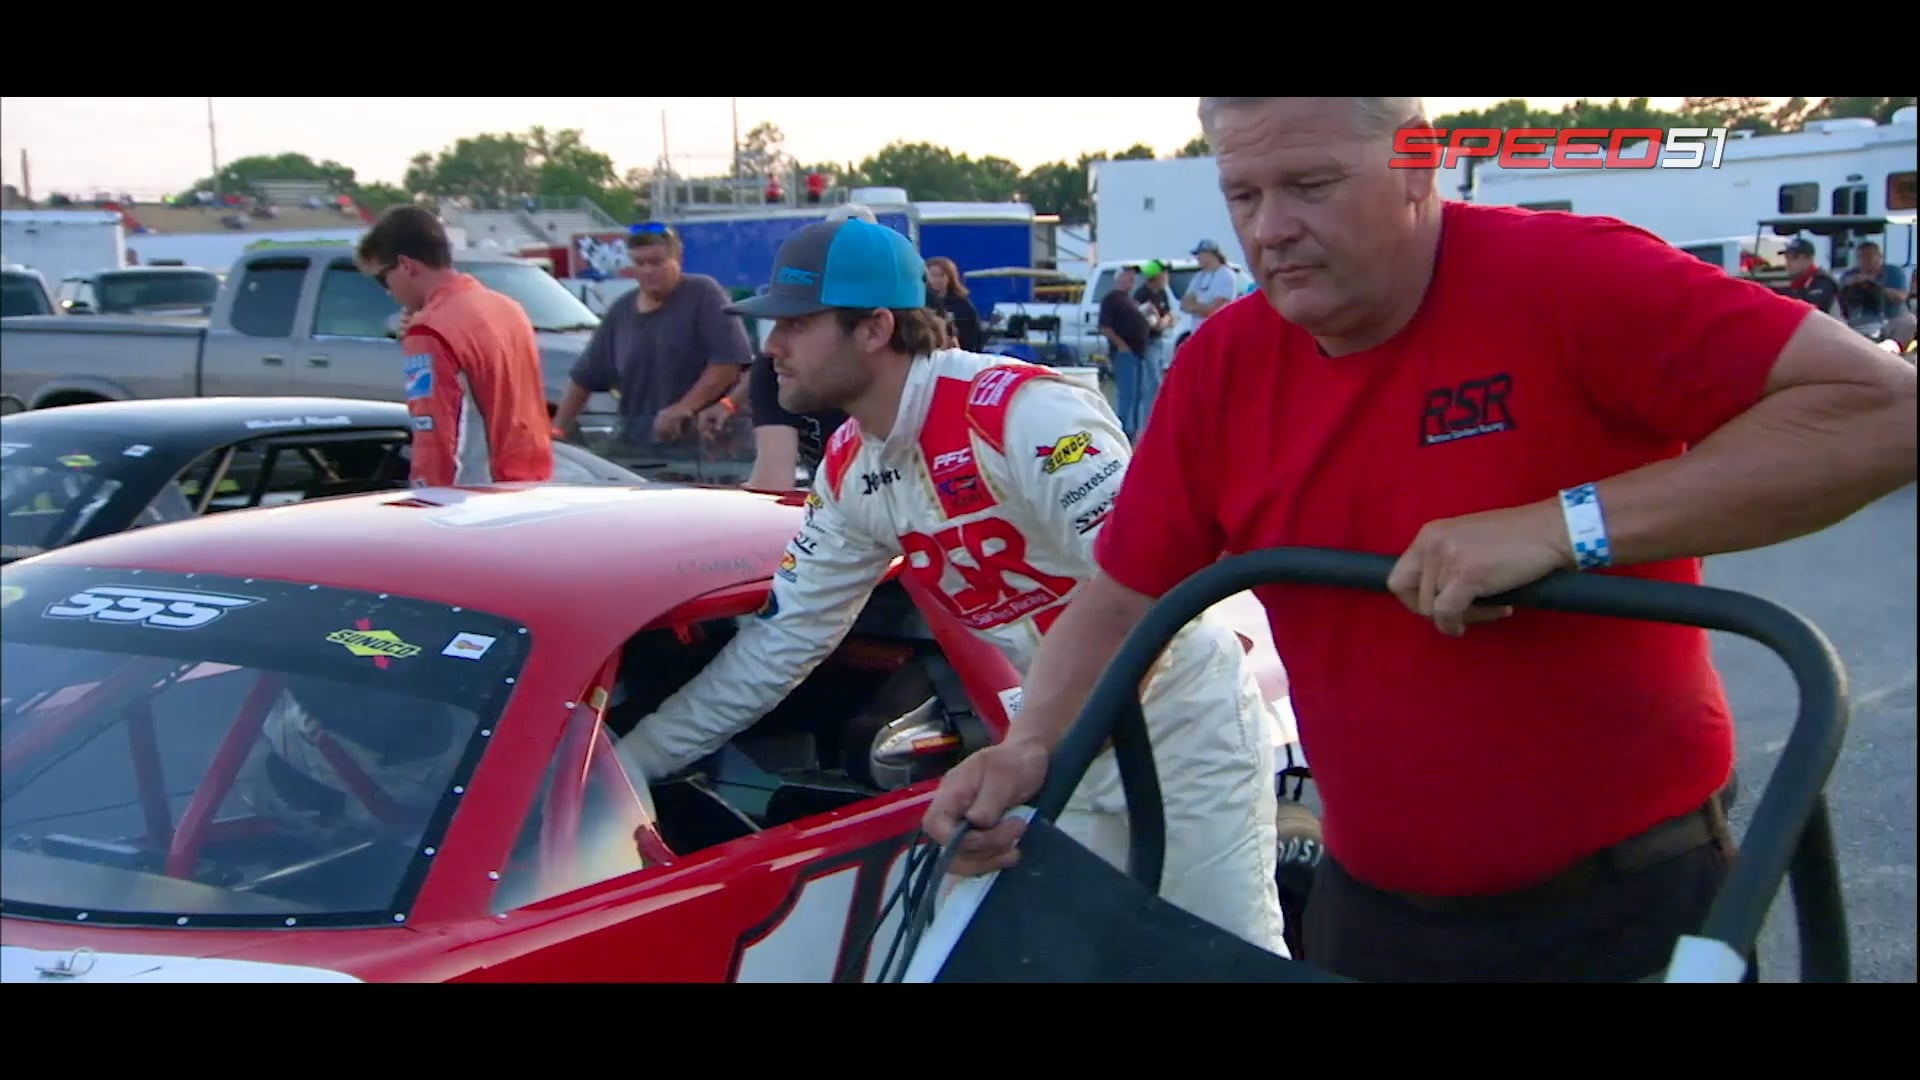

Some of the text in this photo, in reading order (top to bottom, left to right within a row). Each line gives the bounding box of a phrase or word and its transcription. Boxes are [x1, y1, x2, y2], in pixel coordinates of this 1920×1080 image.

[1420, 374, 1516, 446] RSR
[933, 448, 971, 470] PFC
[899, 517, 1077, 614] RSR
[333, 629, 415, 656] SUNOCO
